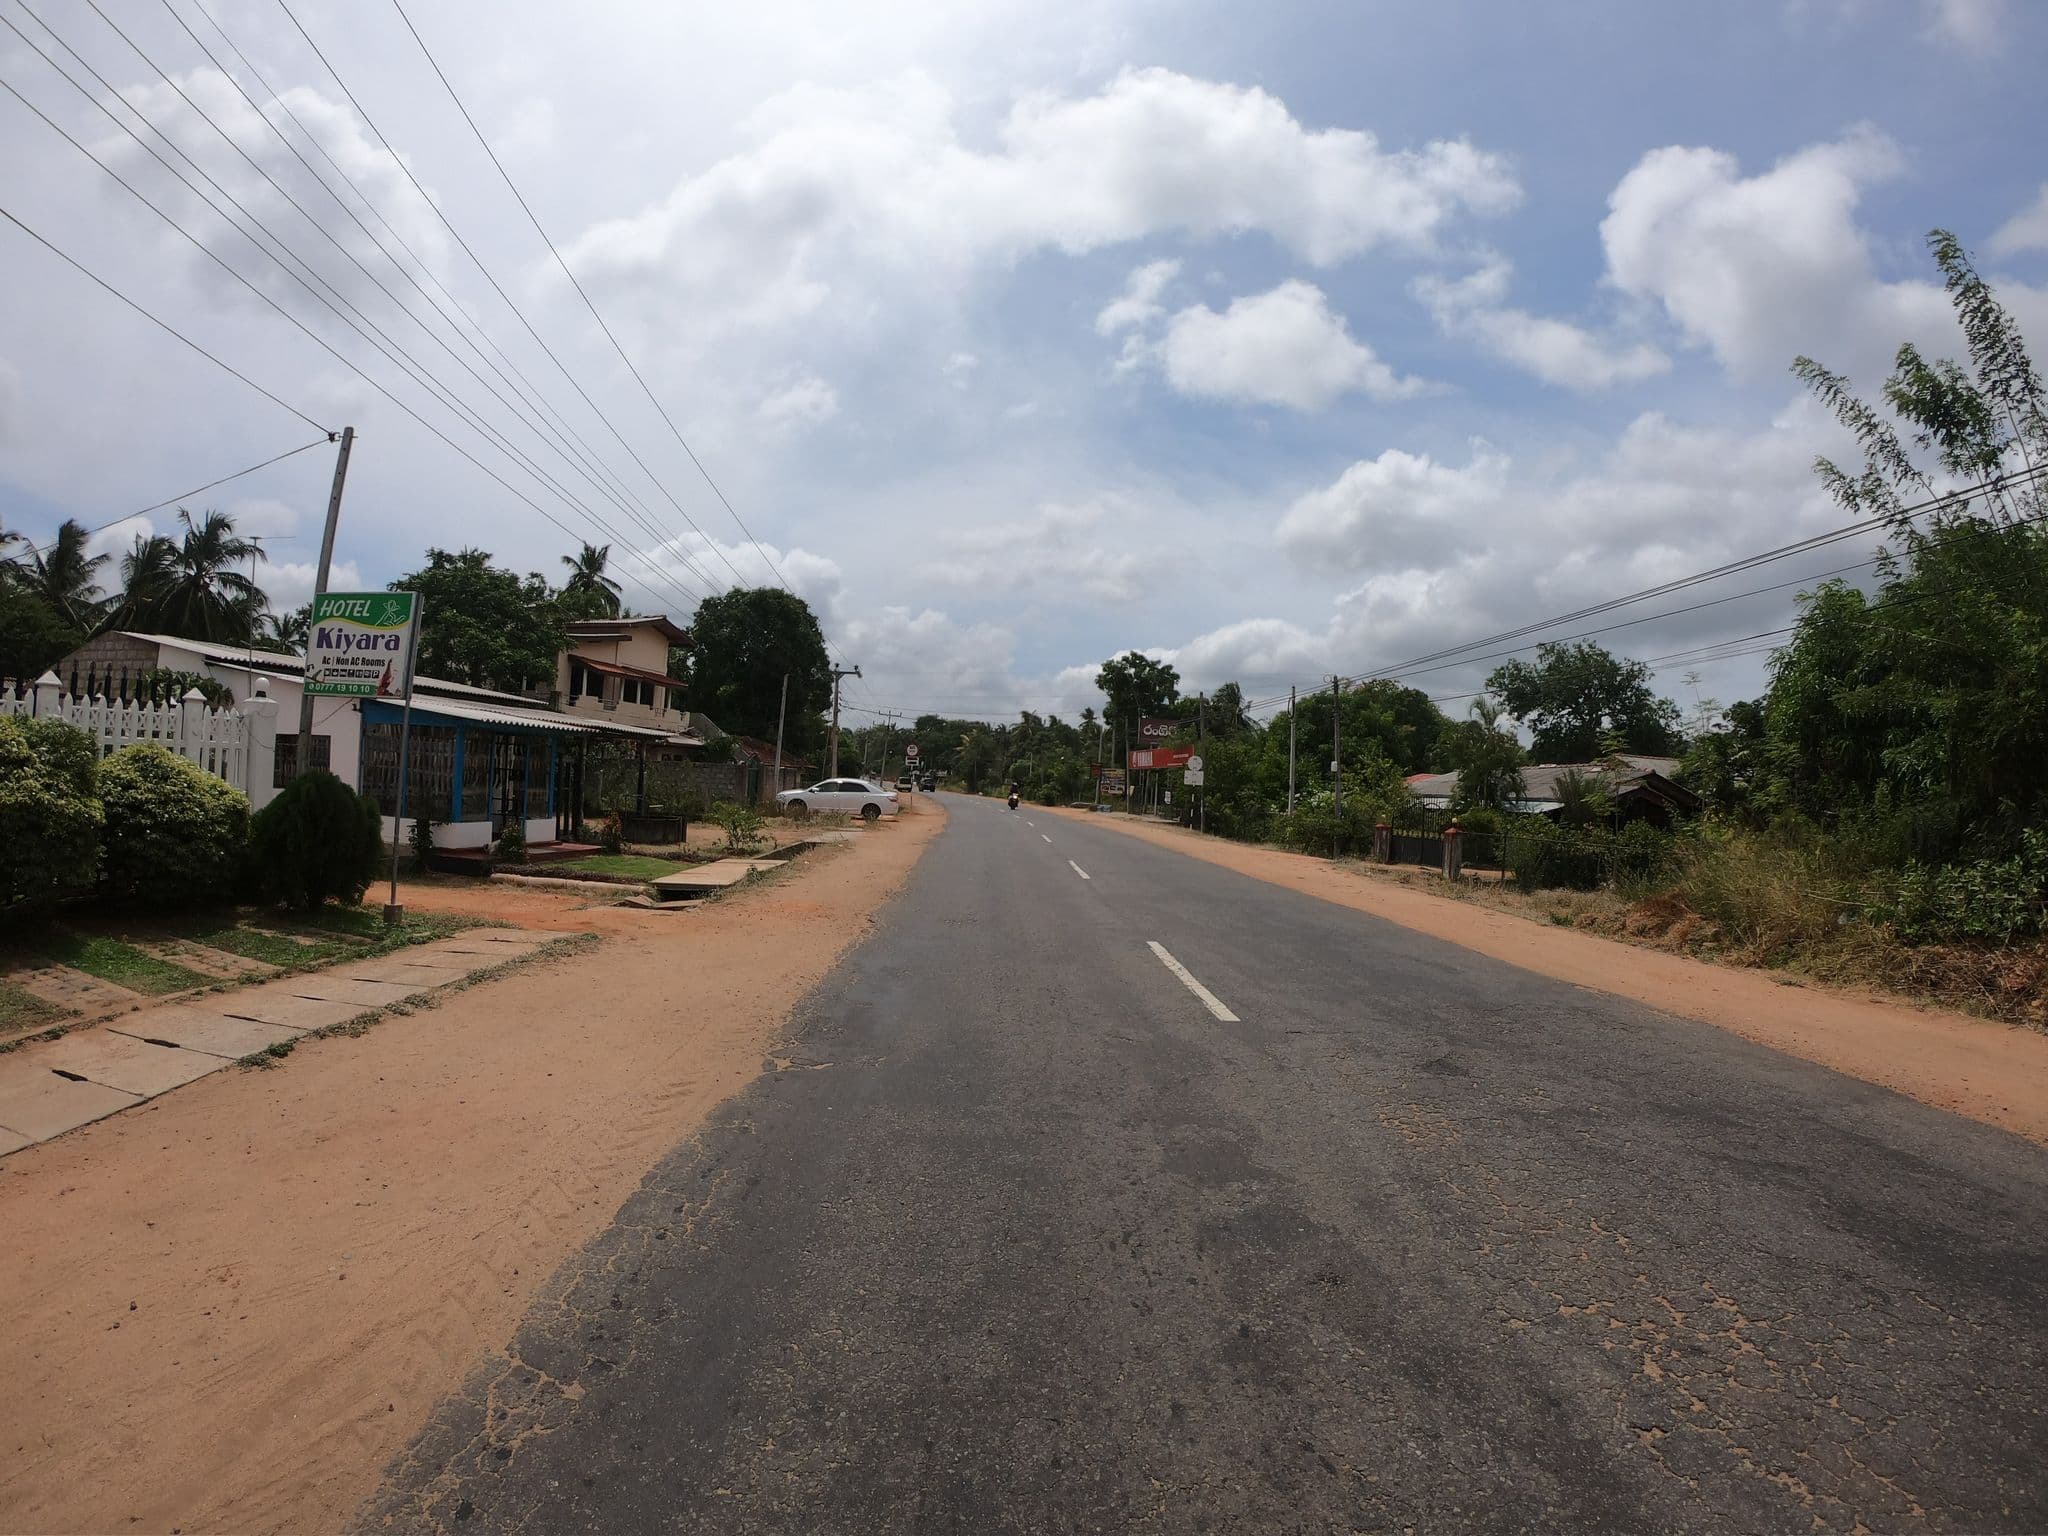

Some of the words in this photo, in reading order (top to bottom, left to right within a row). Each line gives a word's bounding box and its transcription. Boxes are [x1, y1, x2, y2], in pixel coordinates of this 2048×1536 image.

[319, 599, 372, 617] HOTEL
[316, 627, 401, 655] Kiyara
[335, 656, 349, 666] Non
[350, 657, 360, 666] AC
[360, 657, 386, 667] Rooms
[315, 683, 334, 691] 0777
[337, 684, 346, 692] 19
[349, 684, 358, 692] 10
[360, 685, 370, 693] 10
